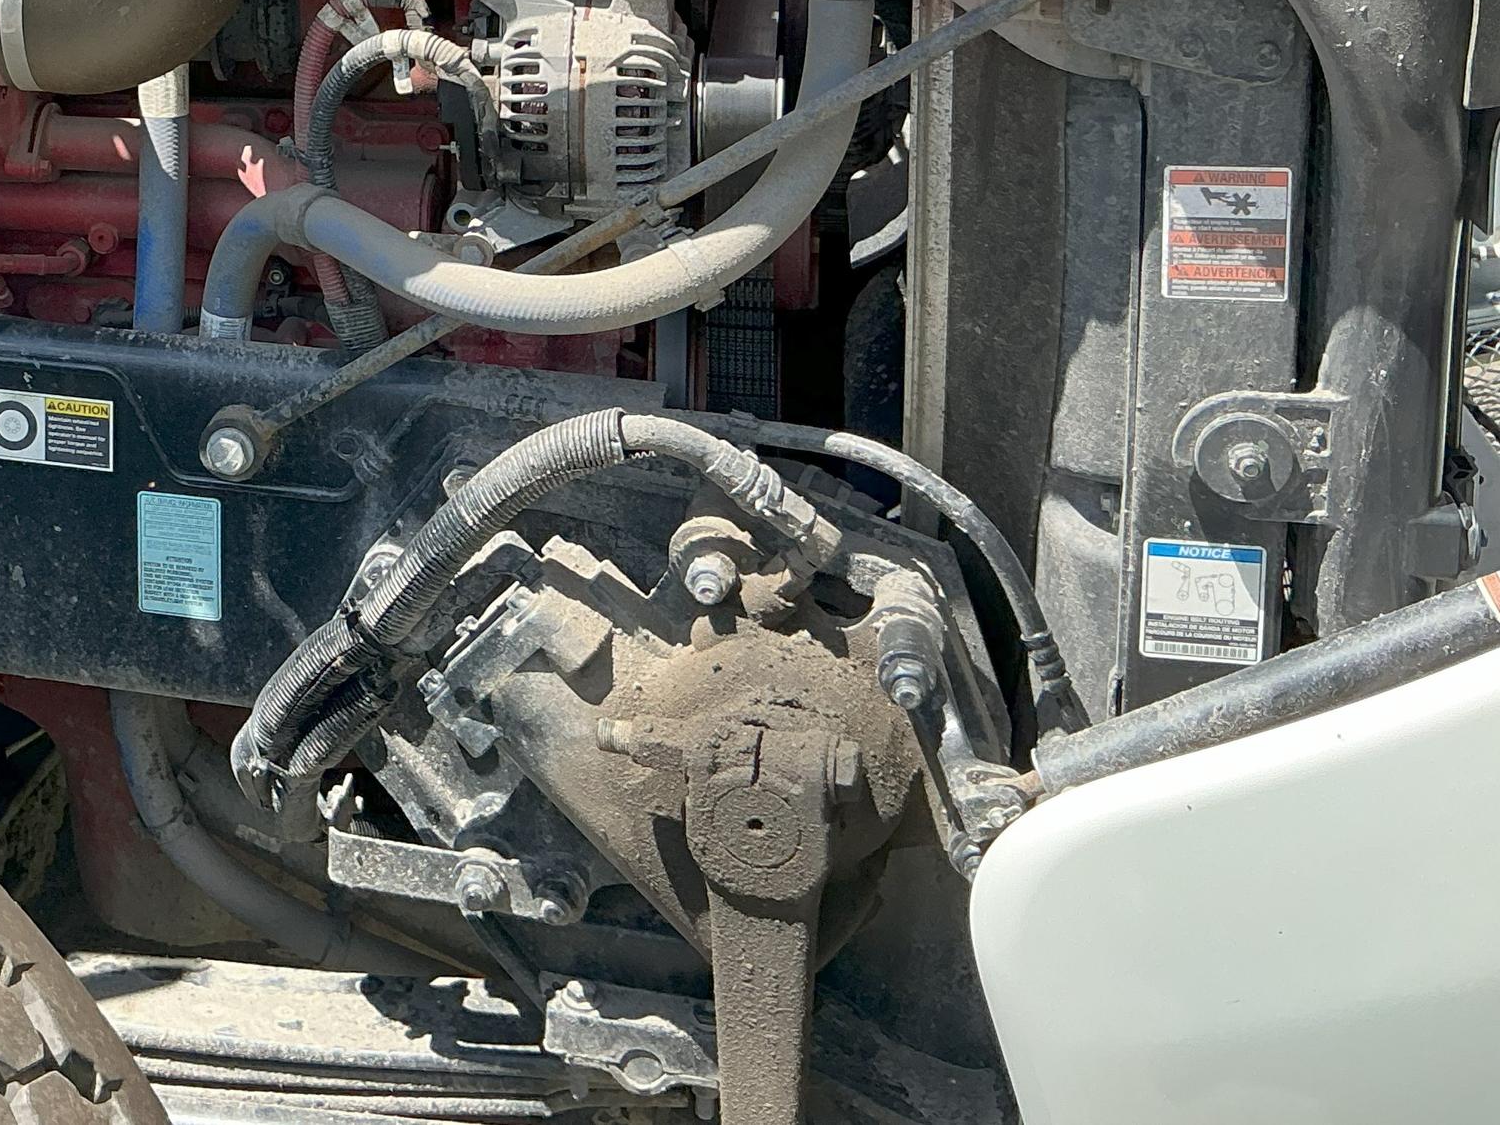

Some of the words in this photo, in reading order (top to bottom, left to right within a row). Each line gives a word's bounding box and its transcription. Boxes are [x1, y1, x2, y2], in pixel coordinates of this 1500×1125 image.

[1208, 173, 1267, 184] WARNING
[1189, 234, 1284, 245] AVERTISSEMENT
[1194, 266, 1277, 278] ADVERTENCIA
[57, 402, 109, 416] CAUTION
[1178, 546, 1232, 559] NOTICE
